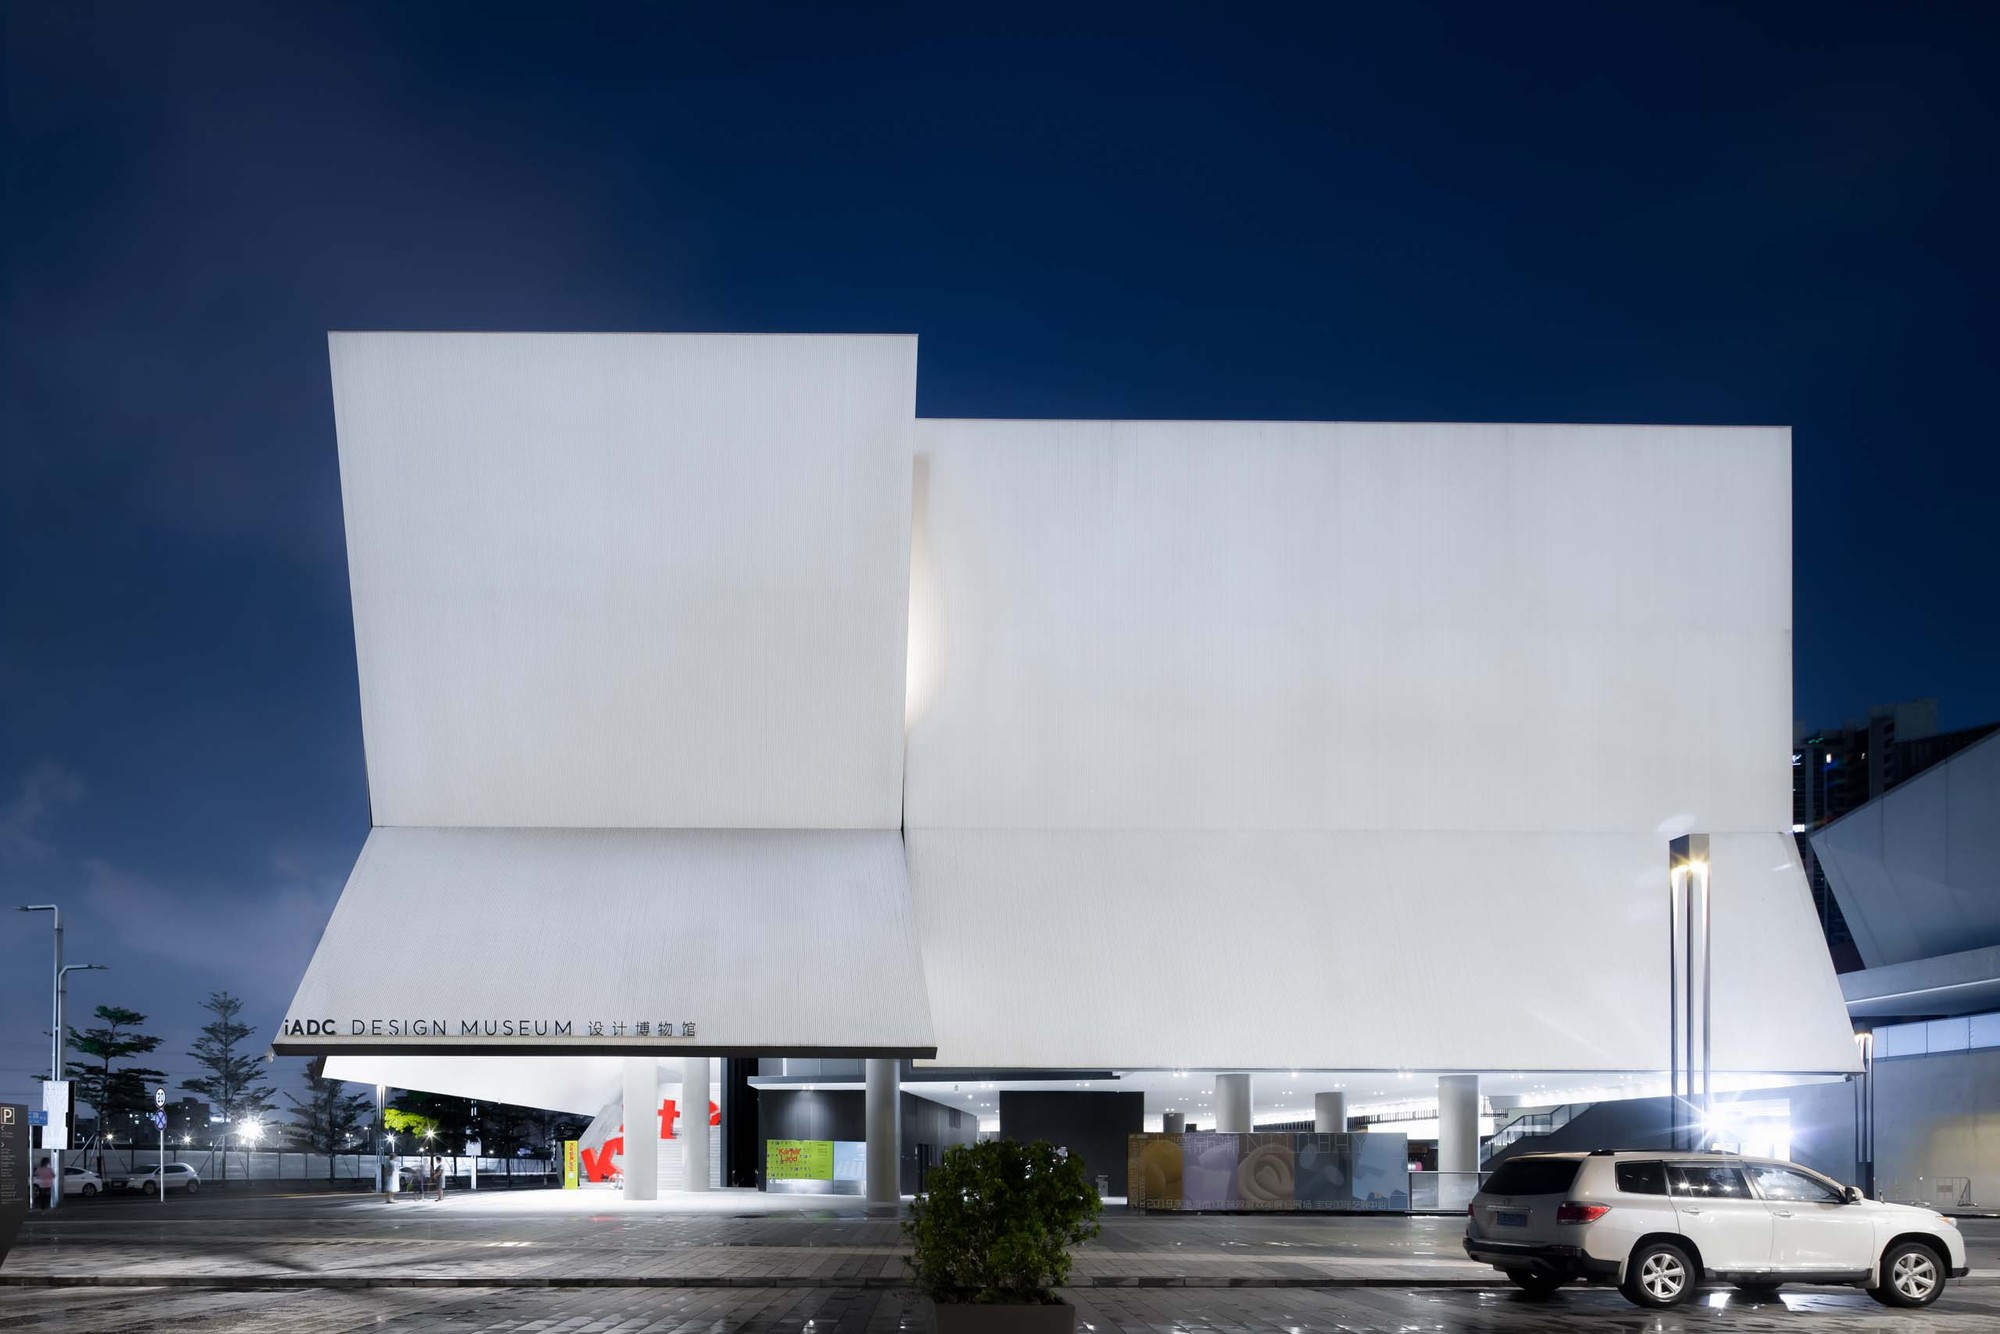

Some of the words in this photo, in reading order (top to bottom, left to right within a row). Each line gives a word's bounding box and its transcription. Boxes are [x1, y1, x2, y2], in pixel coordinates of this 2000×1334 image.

[284, 1019, 336, 1036] iADC
[352, 1019, 446, 1036] DESIGN
[461, 1019, 572, 1036] MUSEUM
[588, 1020, 697, 1037] 设计博物馆
